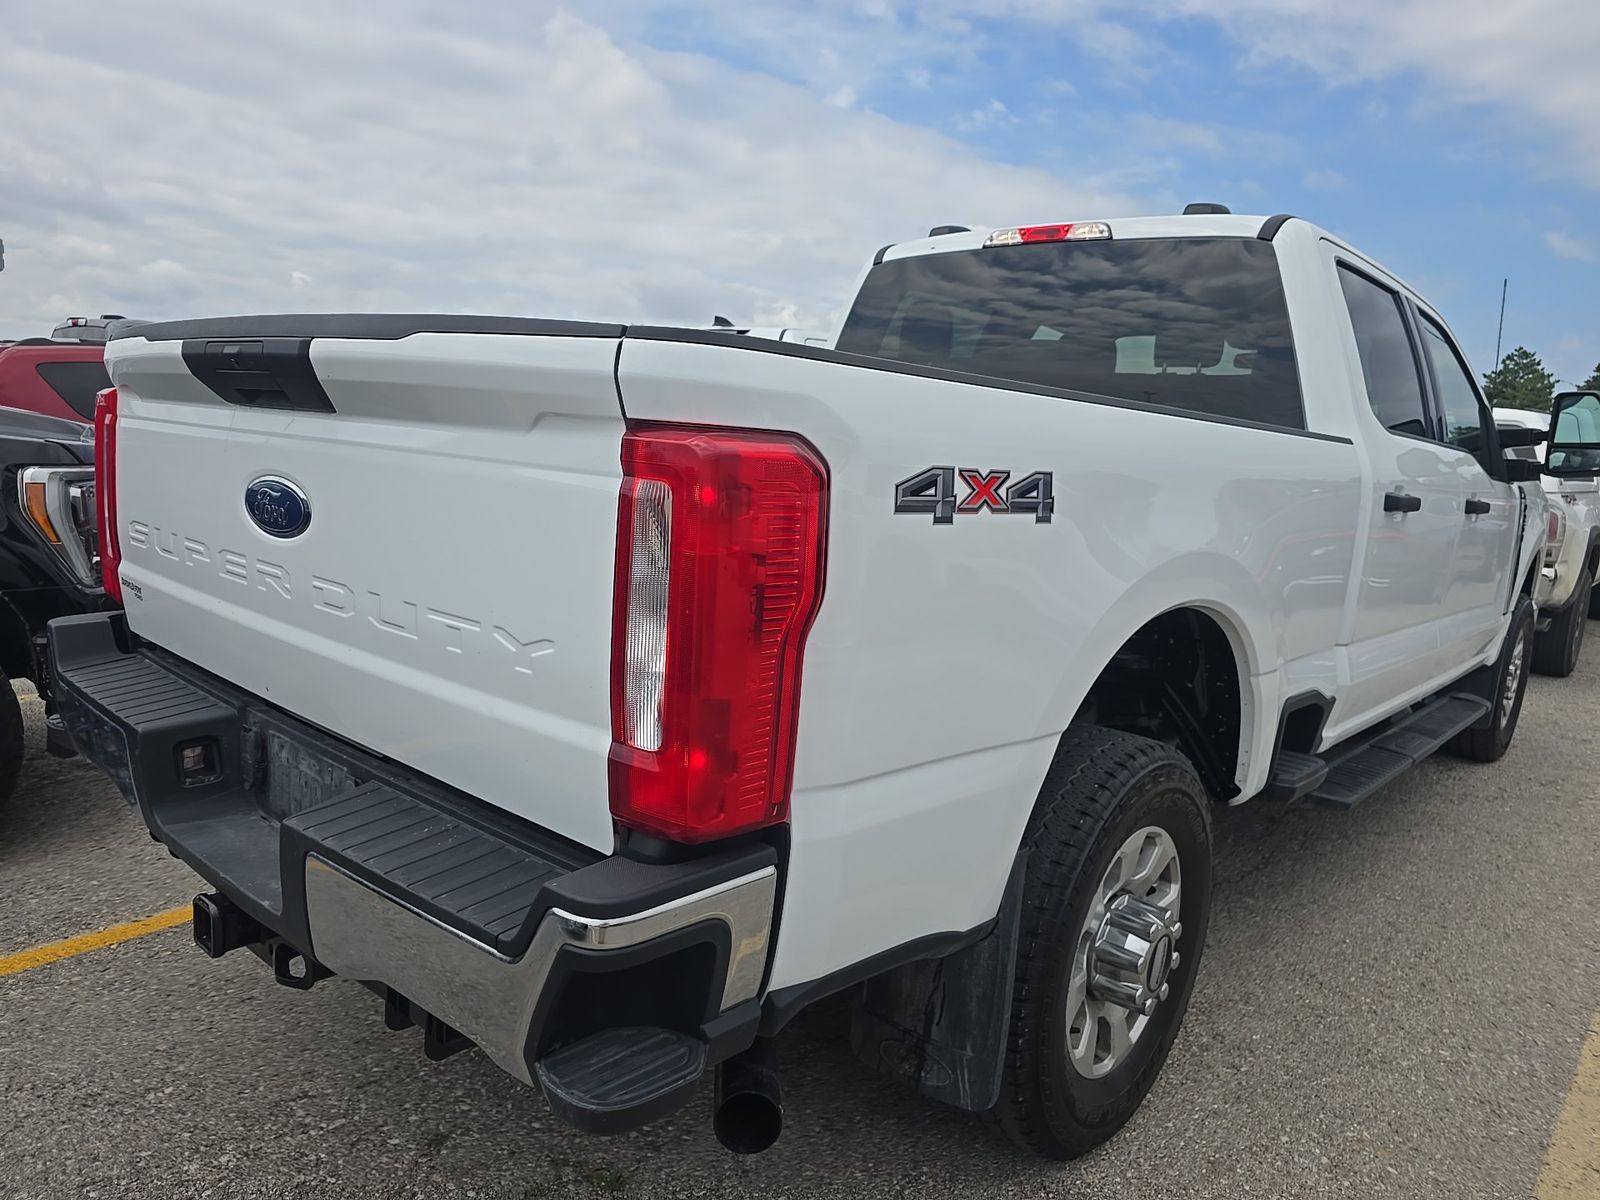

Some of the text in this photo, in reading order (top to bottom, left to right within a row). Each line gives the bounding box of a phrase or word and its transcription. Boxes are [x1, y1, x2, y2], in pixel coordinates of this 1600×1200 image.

[254, 487, 290, 526] Ford
[128, 519, 556, 674] SUPER DUTY
